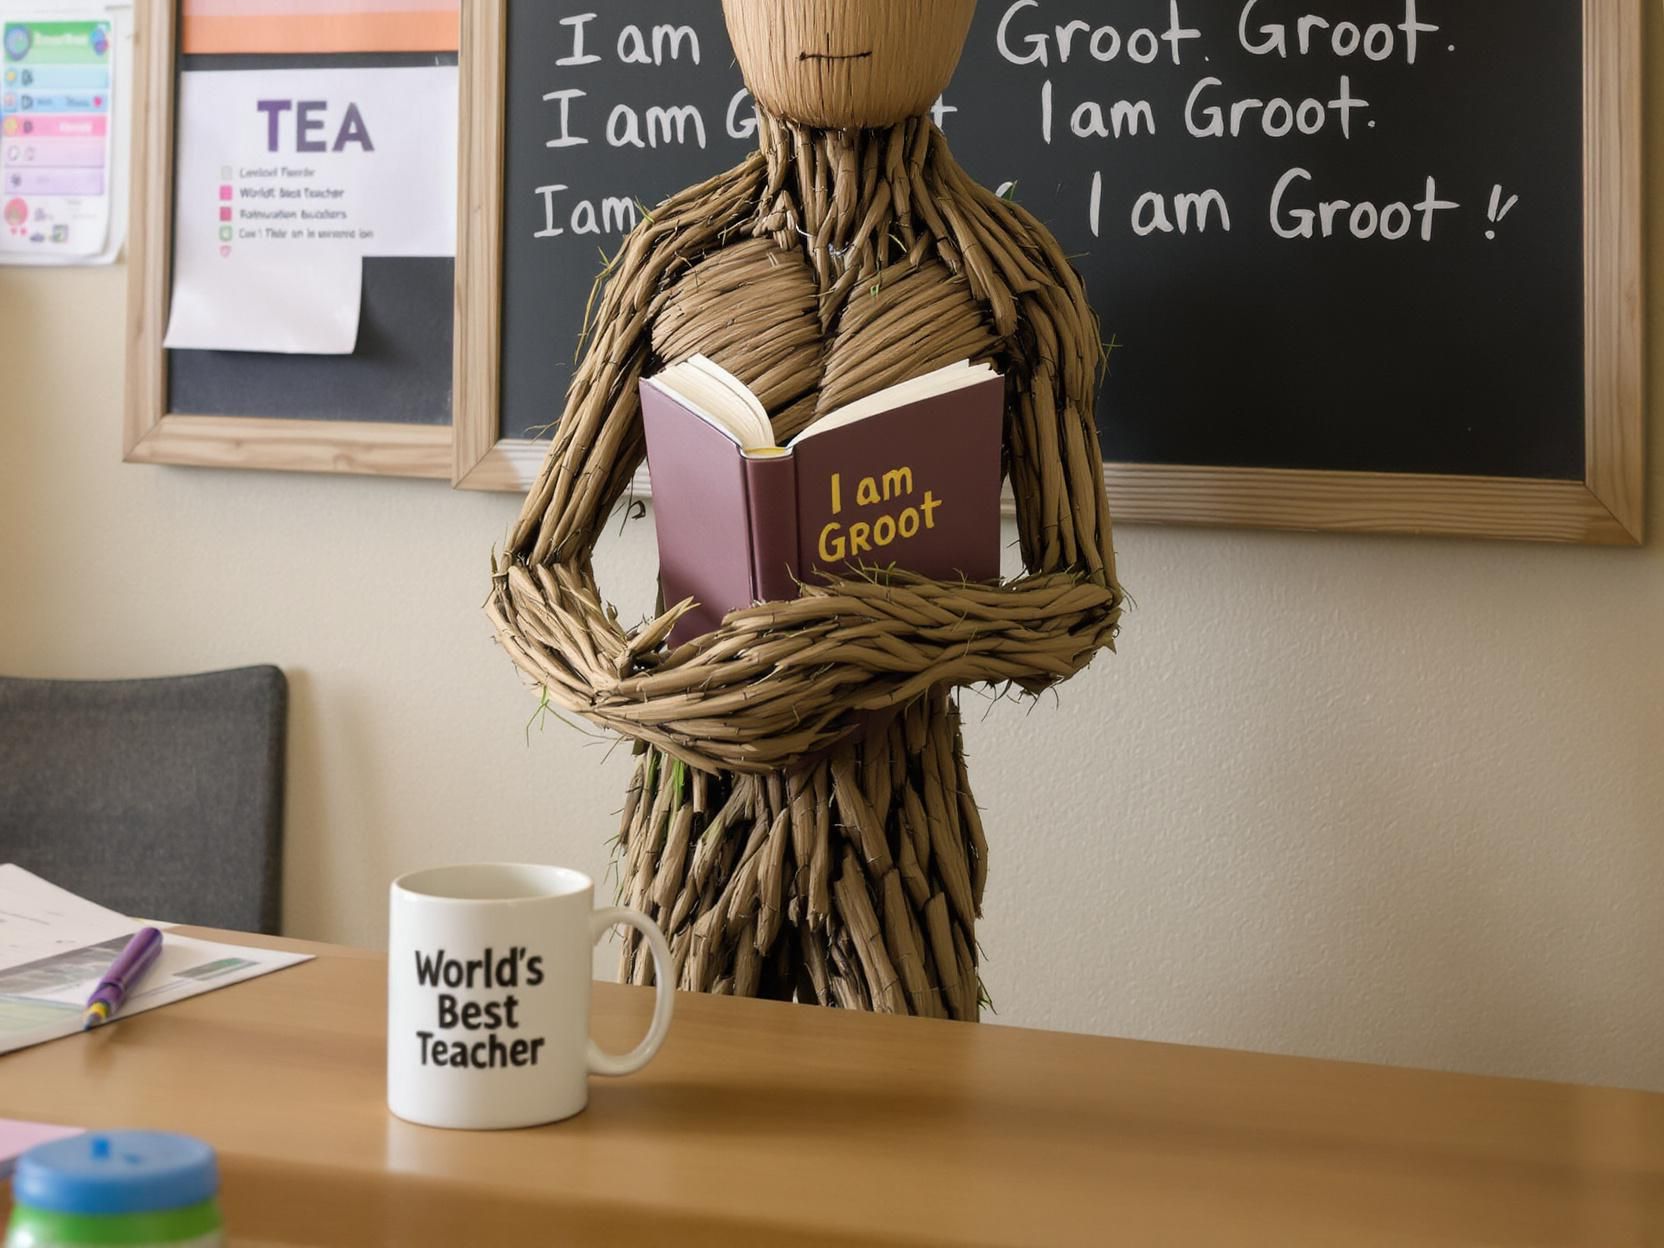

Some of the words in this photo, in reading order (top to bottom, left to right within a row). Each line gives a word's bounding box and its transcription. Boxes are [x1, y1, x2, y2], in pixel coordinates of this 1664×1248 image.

[555, 13, 601, 66] I
[615, 22, 702, 68] am
[257, 99, 375, 153] TEA
[543, 89, 588, 147] I
[604, 102, 708, 151] am
[1183, 74, 1377, 141] Groot.
[1090, 171, 1101, 237] I
[1130, 187, 1232, 238] am
[1268, 166, 1461, 242] Groot
[831, 472, 841, 515] I
[856, 466, 912, 506] am
[415, 946, 544, 989] World's
[438, 993, 519, 1030] Best
[416, 1030, 545, 1069] Teacher
